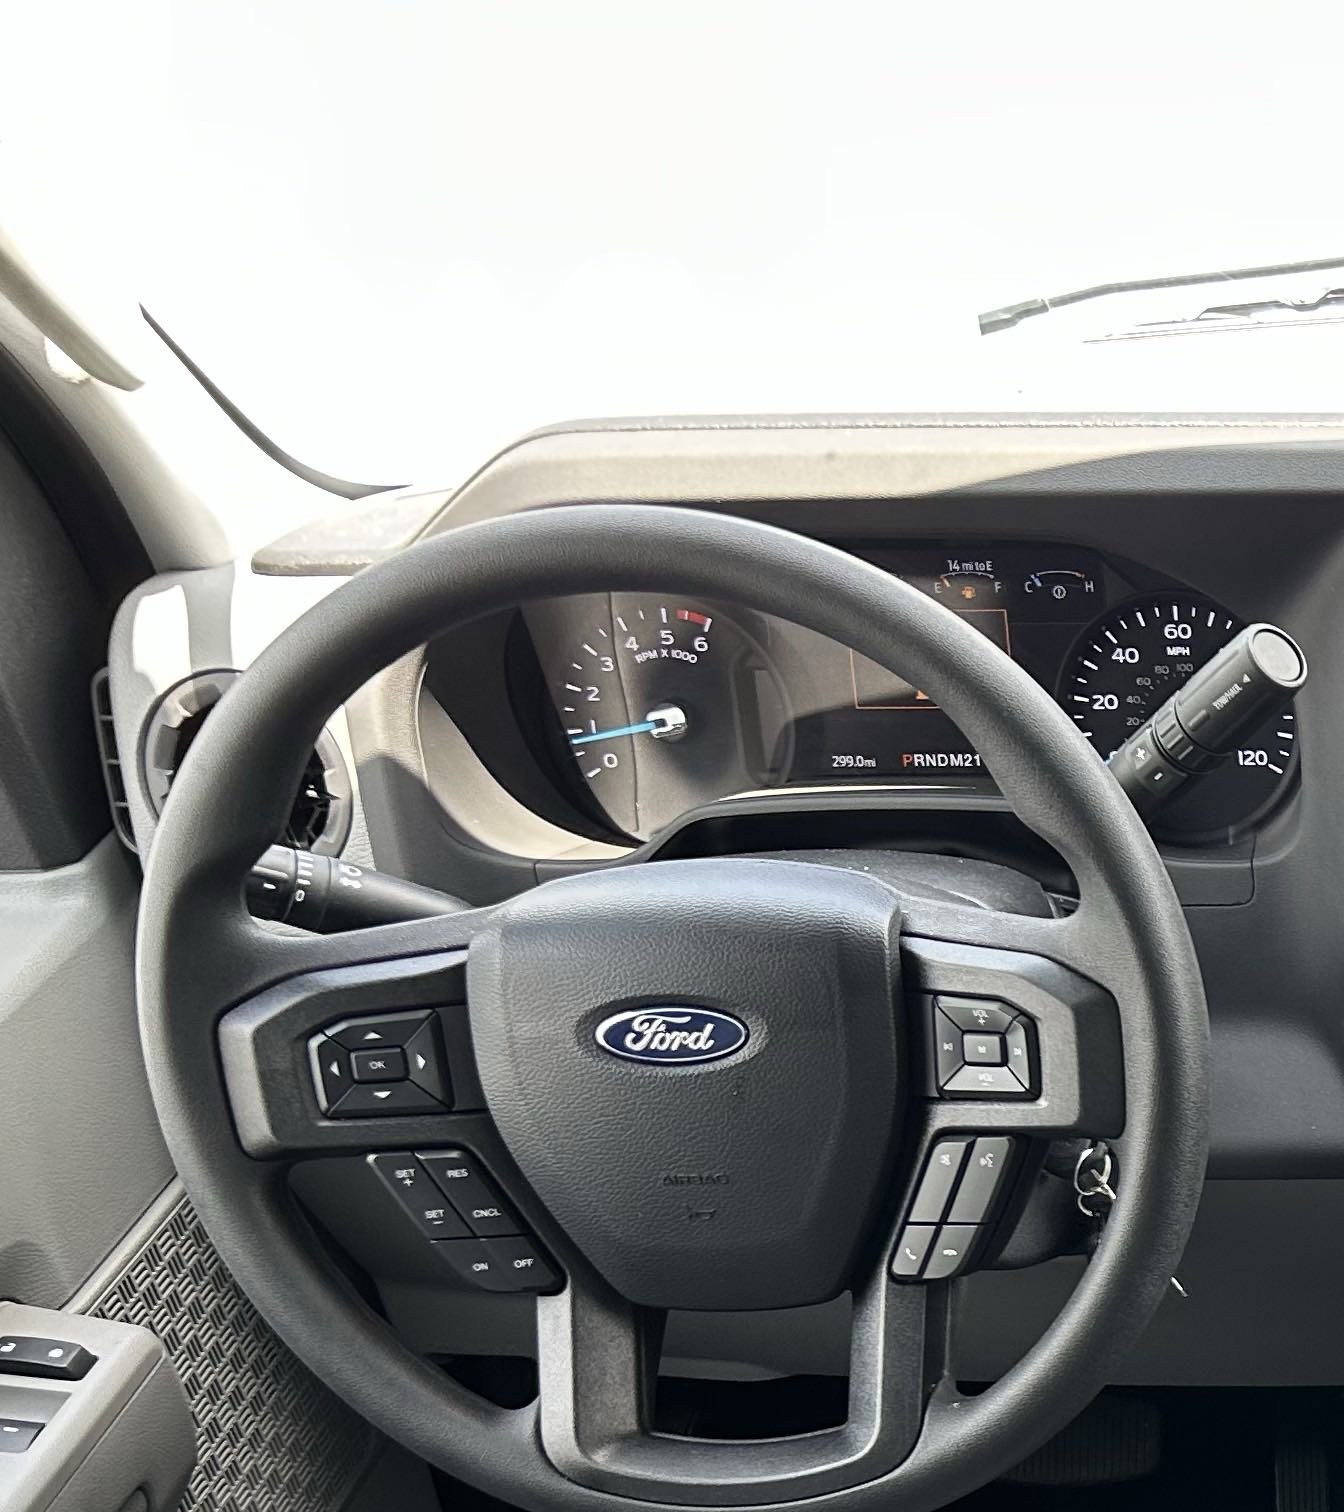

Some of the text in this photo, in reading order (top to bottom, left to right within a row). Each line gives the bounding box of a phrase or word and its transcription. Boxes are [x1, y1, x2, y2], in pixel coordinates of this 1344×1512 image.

[947, 559, 960, 571] 14
[934, 582, 942, 594] E
[994, 581, 1002, 594] F
[1024, 581, 1033, 593] C
[1085, 580, 1095, 593] H
[660, 630, 674, 645] 5
[1163, 624, 1192, 639] 60
[625, 636, 640, 651] 4
[693, 637, 709, 652] 6
[634, 650, 658, 664] RPM
[671, 650, 698, 664] 1000
[1111, 648, 1139, 663] 40
[1166, 646, 1190, 656] MPH
[600, 656, 614, 671] 3
[586, 686, 600, 701] 2
[1092, 694, 1119, 710] 20
[603, 753, 618, 768] 0
[1237, 750, 1268, 766] 120
[624, 1015, 715, 1051] Ford
[369, 1060, 385, 1070] OK
[394, 1169, 415, 1179] SET
[446, 1168, 469, 1178] RES
[424, 1209, 445, 1219] SET
[472, 1208, 502, 1218] CNCL
[472, 1263, 489, 1272] ON
[514, 1258, 534, 1268] OFF
